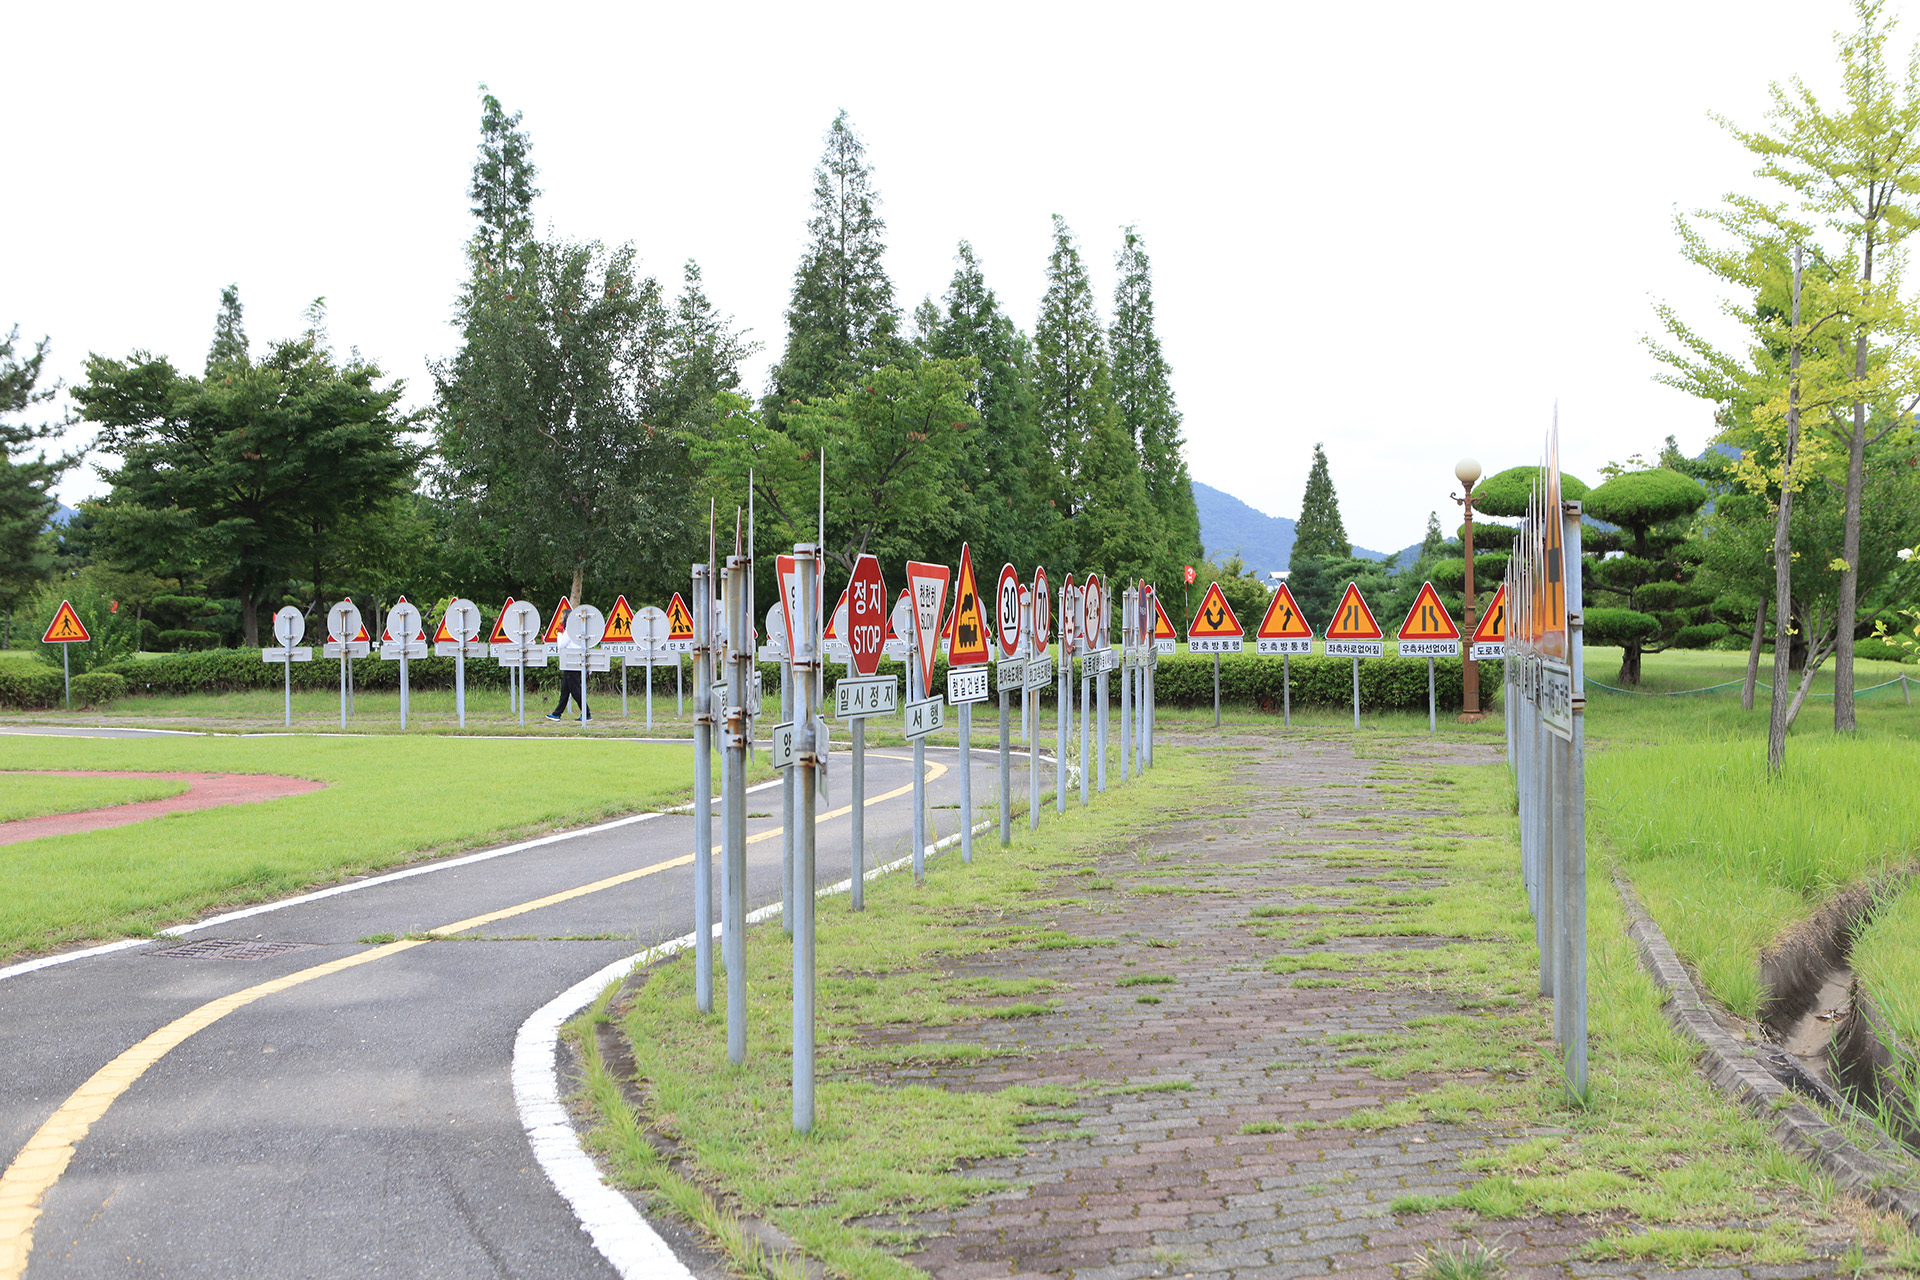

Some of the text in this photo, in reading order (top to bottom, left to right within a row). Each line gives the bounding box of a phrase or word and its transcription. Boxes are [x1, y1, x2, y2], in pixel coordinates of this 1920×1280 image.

[853, 580, 881, 614] 정지
[920, 584, 936, 608] 천천히
[1003, 586, 1016, 624] 30
[1038, 592, 1047, 631] 70
[853, 625, 880, 655] STOP
[1191, 641, 1240, 651] 양측방통행
[1260, 642, 1309, 652] 우측방통행
[1328, 644, 1380, 655] 좌측차로없어짐
[1402, 644, 1456, 654] 우측차선없어짐
[840, 684, 894, 711] 일시정지
[952, 675, 986, 698] 철길건널목
[912, 704, 940, 730] 서행
[783, 732, 792, 757] 양
